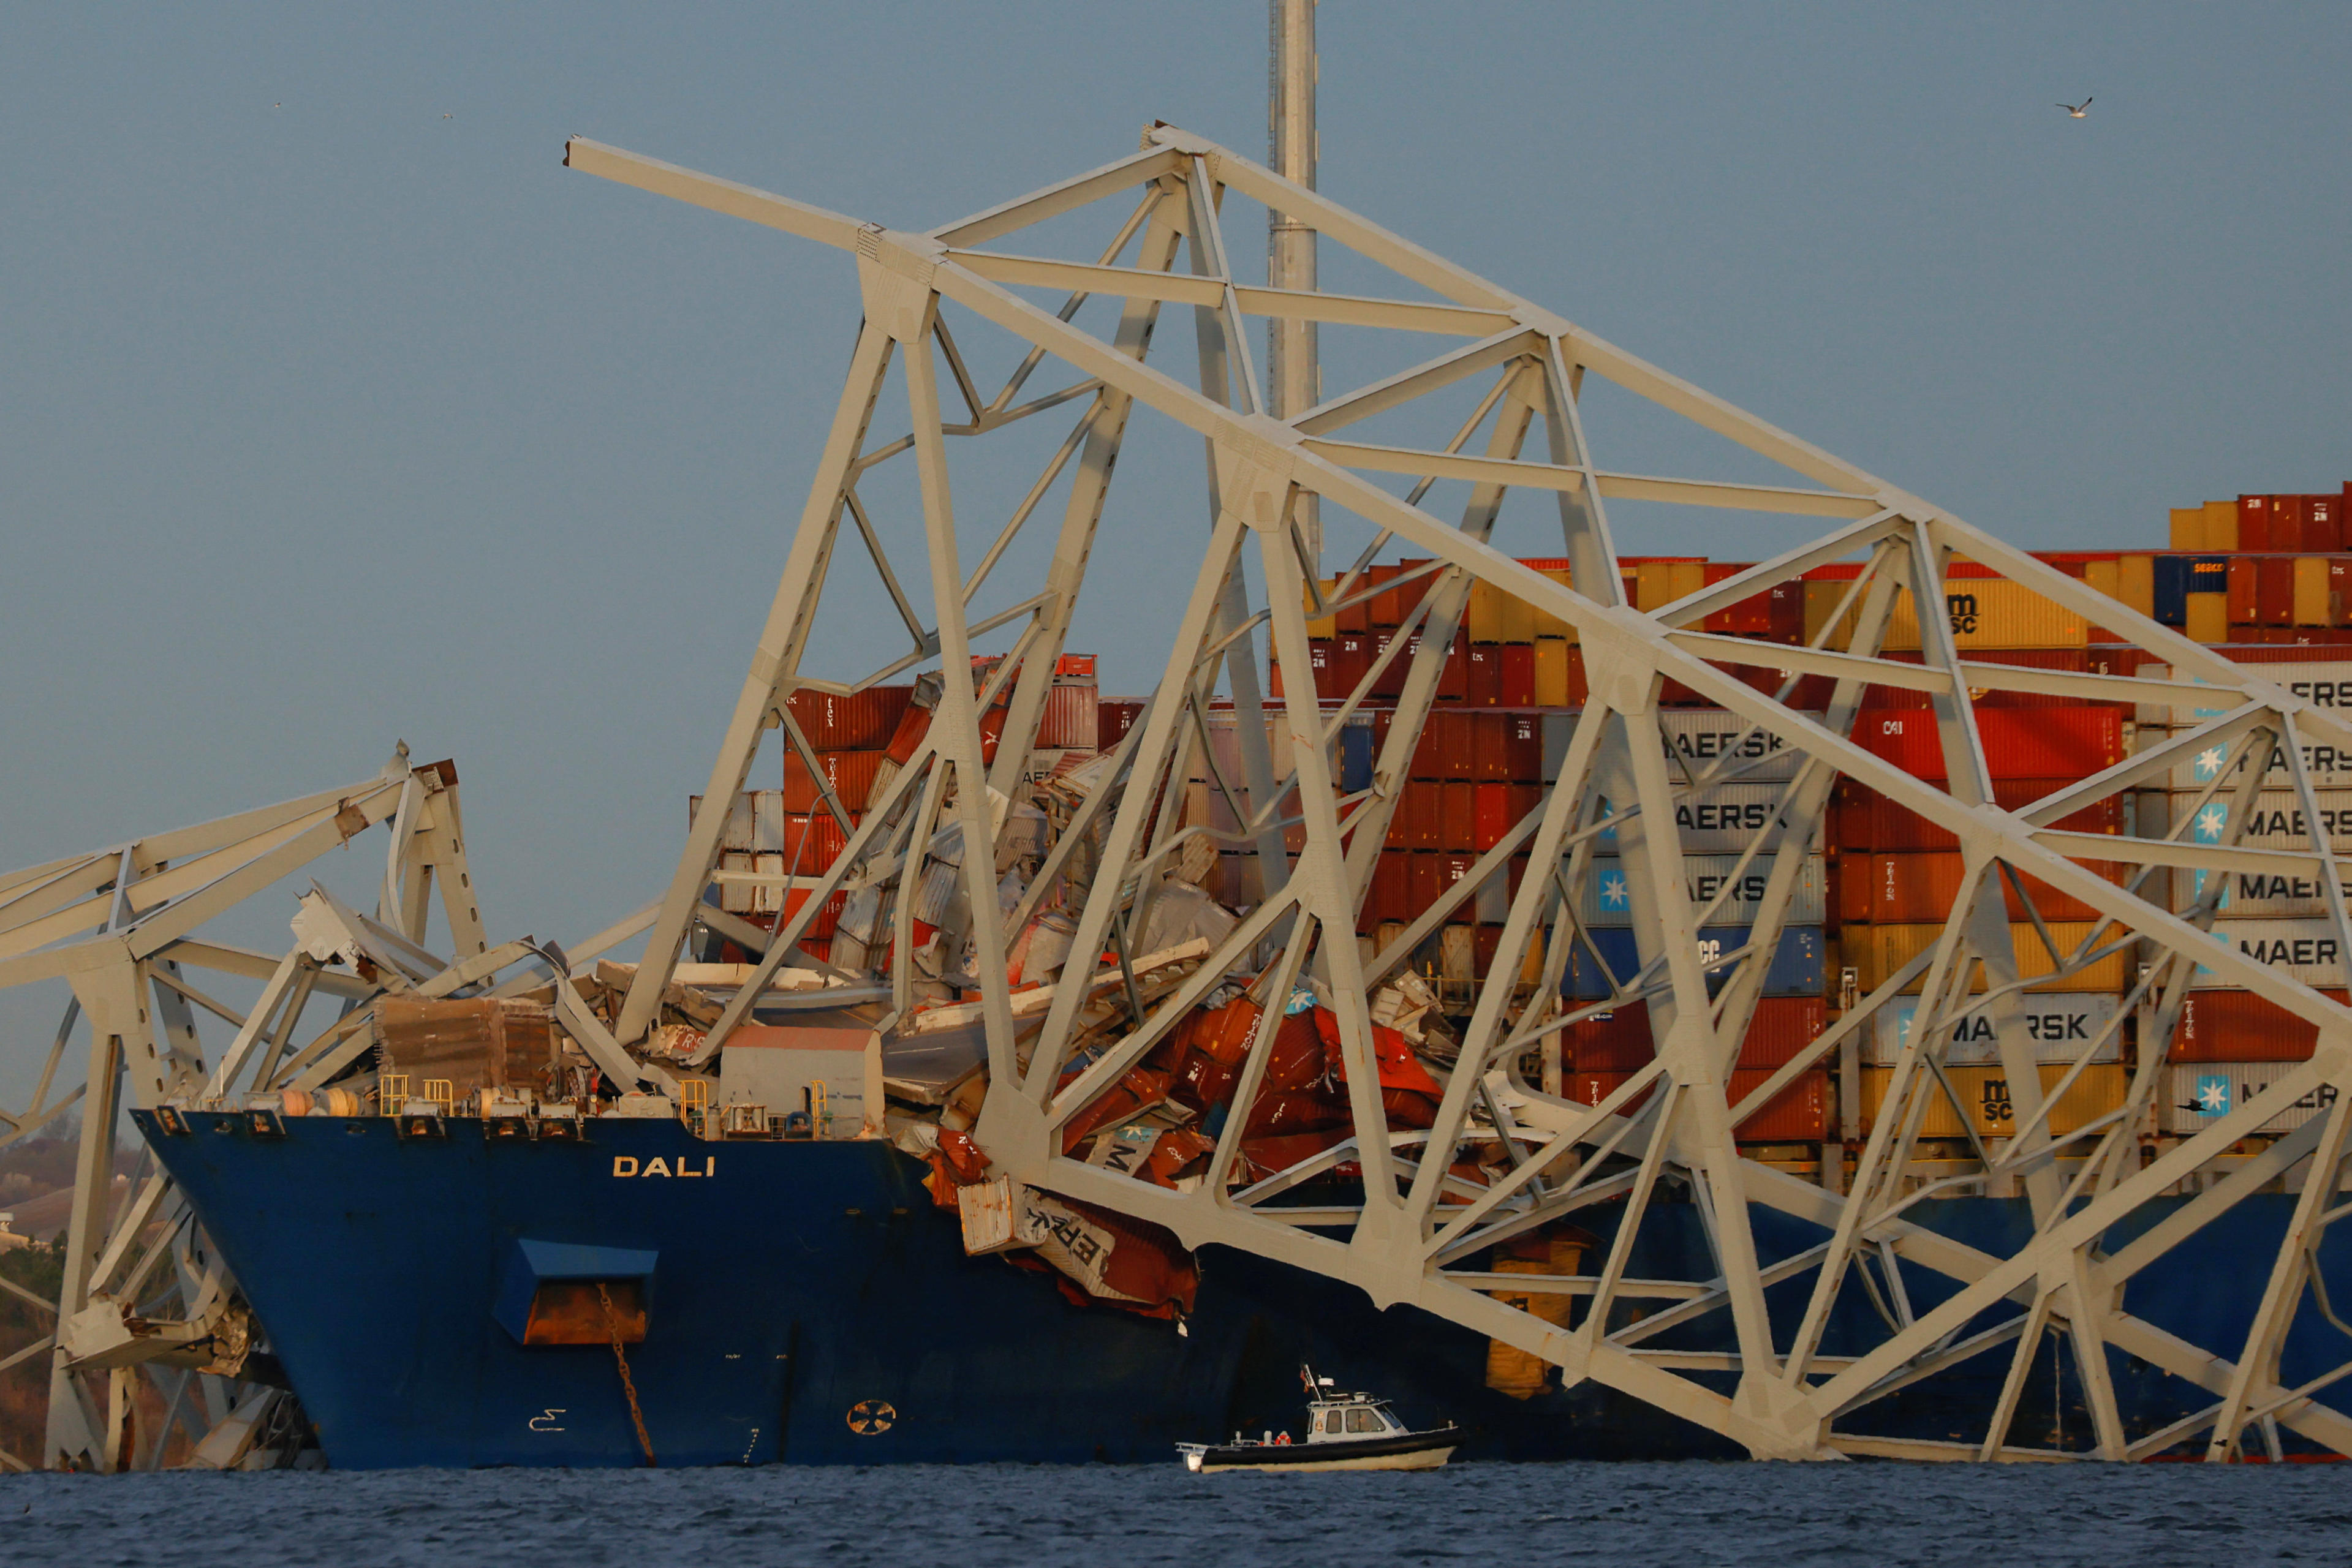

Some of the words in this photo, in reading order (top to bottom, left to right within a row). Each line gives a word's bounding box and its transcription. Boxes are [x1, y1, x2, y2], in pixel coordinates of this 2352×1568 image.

[2194, 563, 2225, 573] seaco
[1883, 721, 1902, 735] CAI
[1953, 1014, 2089, 1041] MARSK
[613, 1156, 716, 1177] DALI
